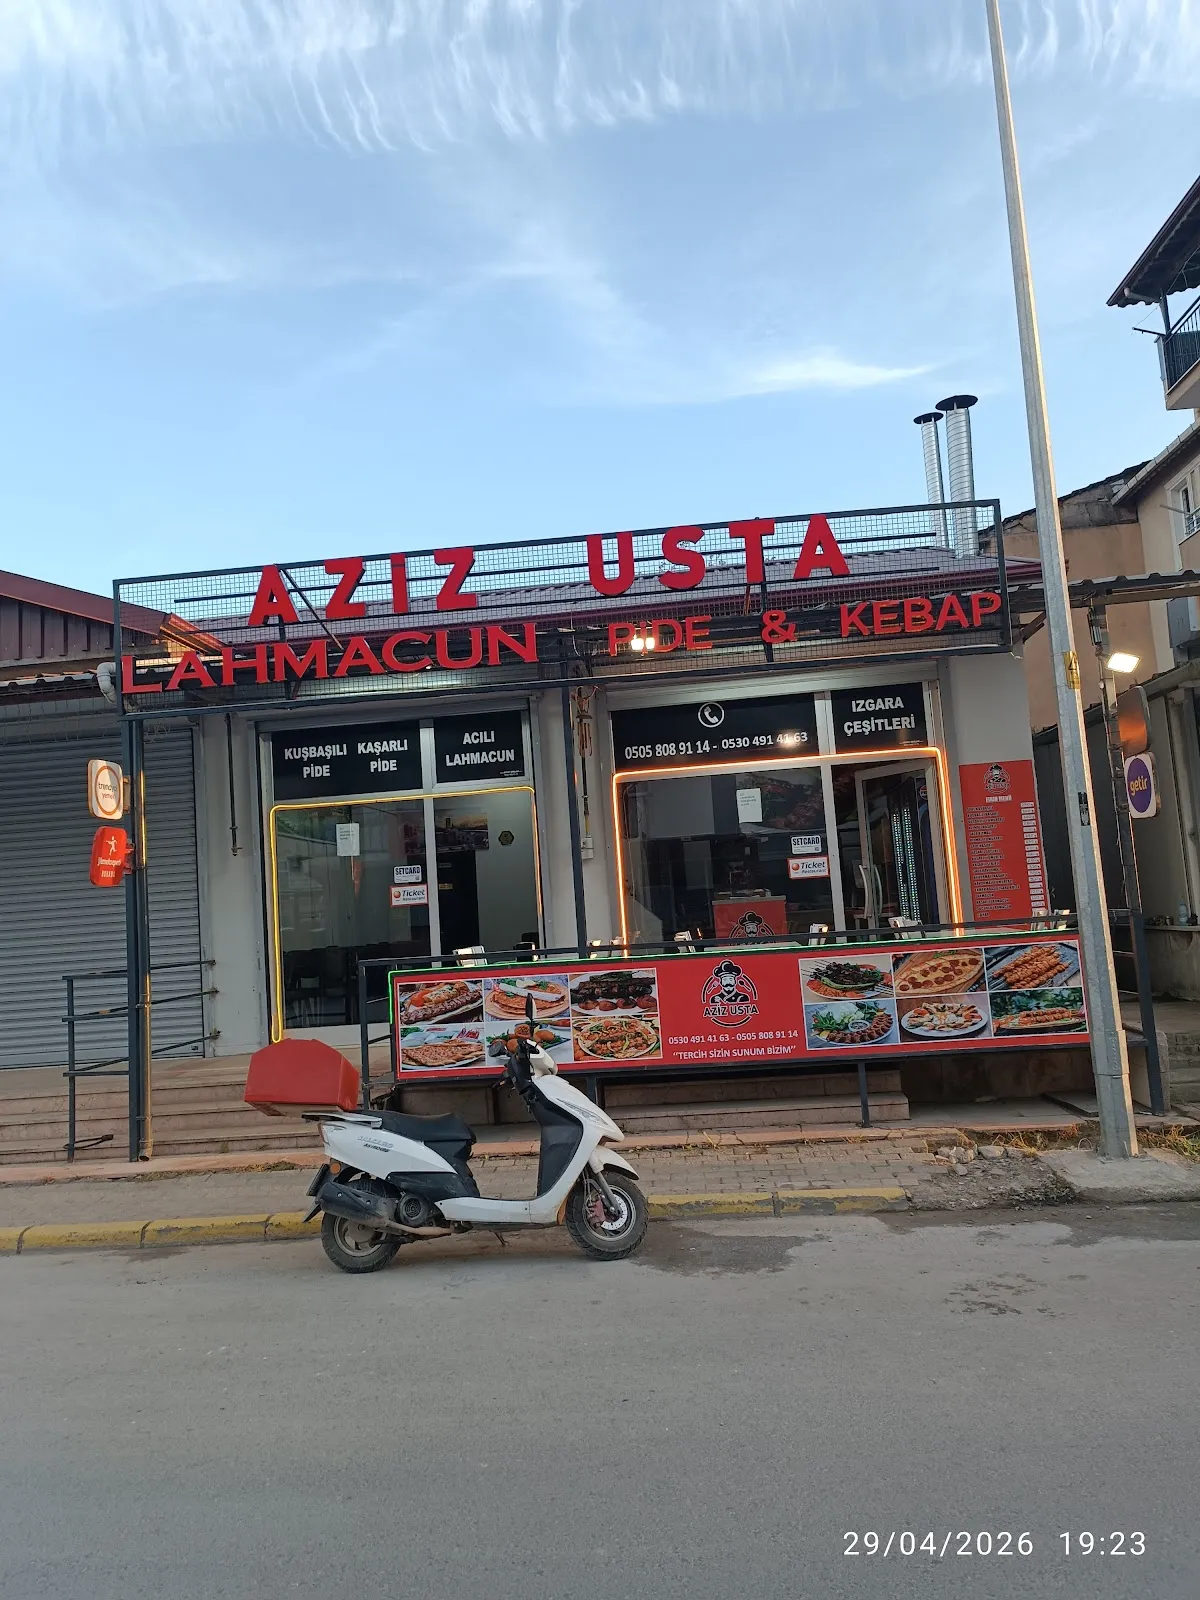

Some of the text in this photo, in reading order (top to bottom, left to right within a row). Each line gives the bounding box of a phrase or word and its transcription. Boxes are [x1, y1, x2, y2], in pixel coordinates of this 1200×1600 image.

[586, 513, 850, 596] USTA
[121, 622, 539, 694] LAHMACUN
[761, 609, 797, 644] &
[840, 591, 1002, 638] KEBAP
[851, 696, 905, 713] IZGARA
[843, 713, 916, 737] ÇEŞİTLERİ
[462, 730, 495, 745] ACILI
[624, 746, 652, 760] 0505
[655, 742, 677, 757] 808
[678, 741, 693, 755] 91
[695, 739, 711, 754] 14
[722, 736, 750, 750] 0530
[752, 734, 774, 747] 491
[793, 731, 808, 743] 63
[284, 739, 408, 762] KUŞBAŞILI KAŞARLI
[445, 749, 515, 767] LAHMACUN
[303, 757, 398, 779] PİDE PİDE
[1129, 775, 1148, 797] getir
[792, 836, 820, 846] SETCARD
[395, 866, 421, 876] SETCARD
[801, 861, 825, 869] Ticket
[402, 889, 425, 897] Ticket
[729, 1004, 760, 1016] USTA
[668, 1036, 689, 1045] 0530
[690, 1035, 706, 1044] 491
[707, 1034, 718, 1043] 41
[719, 1033, 730, 1042] 63
[736, 1032, 757, 1041] 0505
[758, 1031, 774, 1040] 808
[775, 1030, 786, 1039] 91
[787, 1030, 799, 1038] 14
[709, 1048, 731, 1058] SİZİN
[732, 1047, 765, 1057] SUNUM
